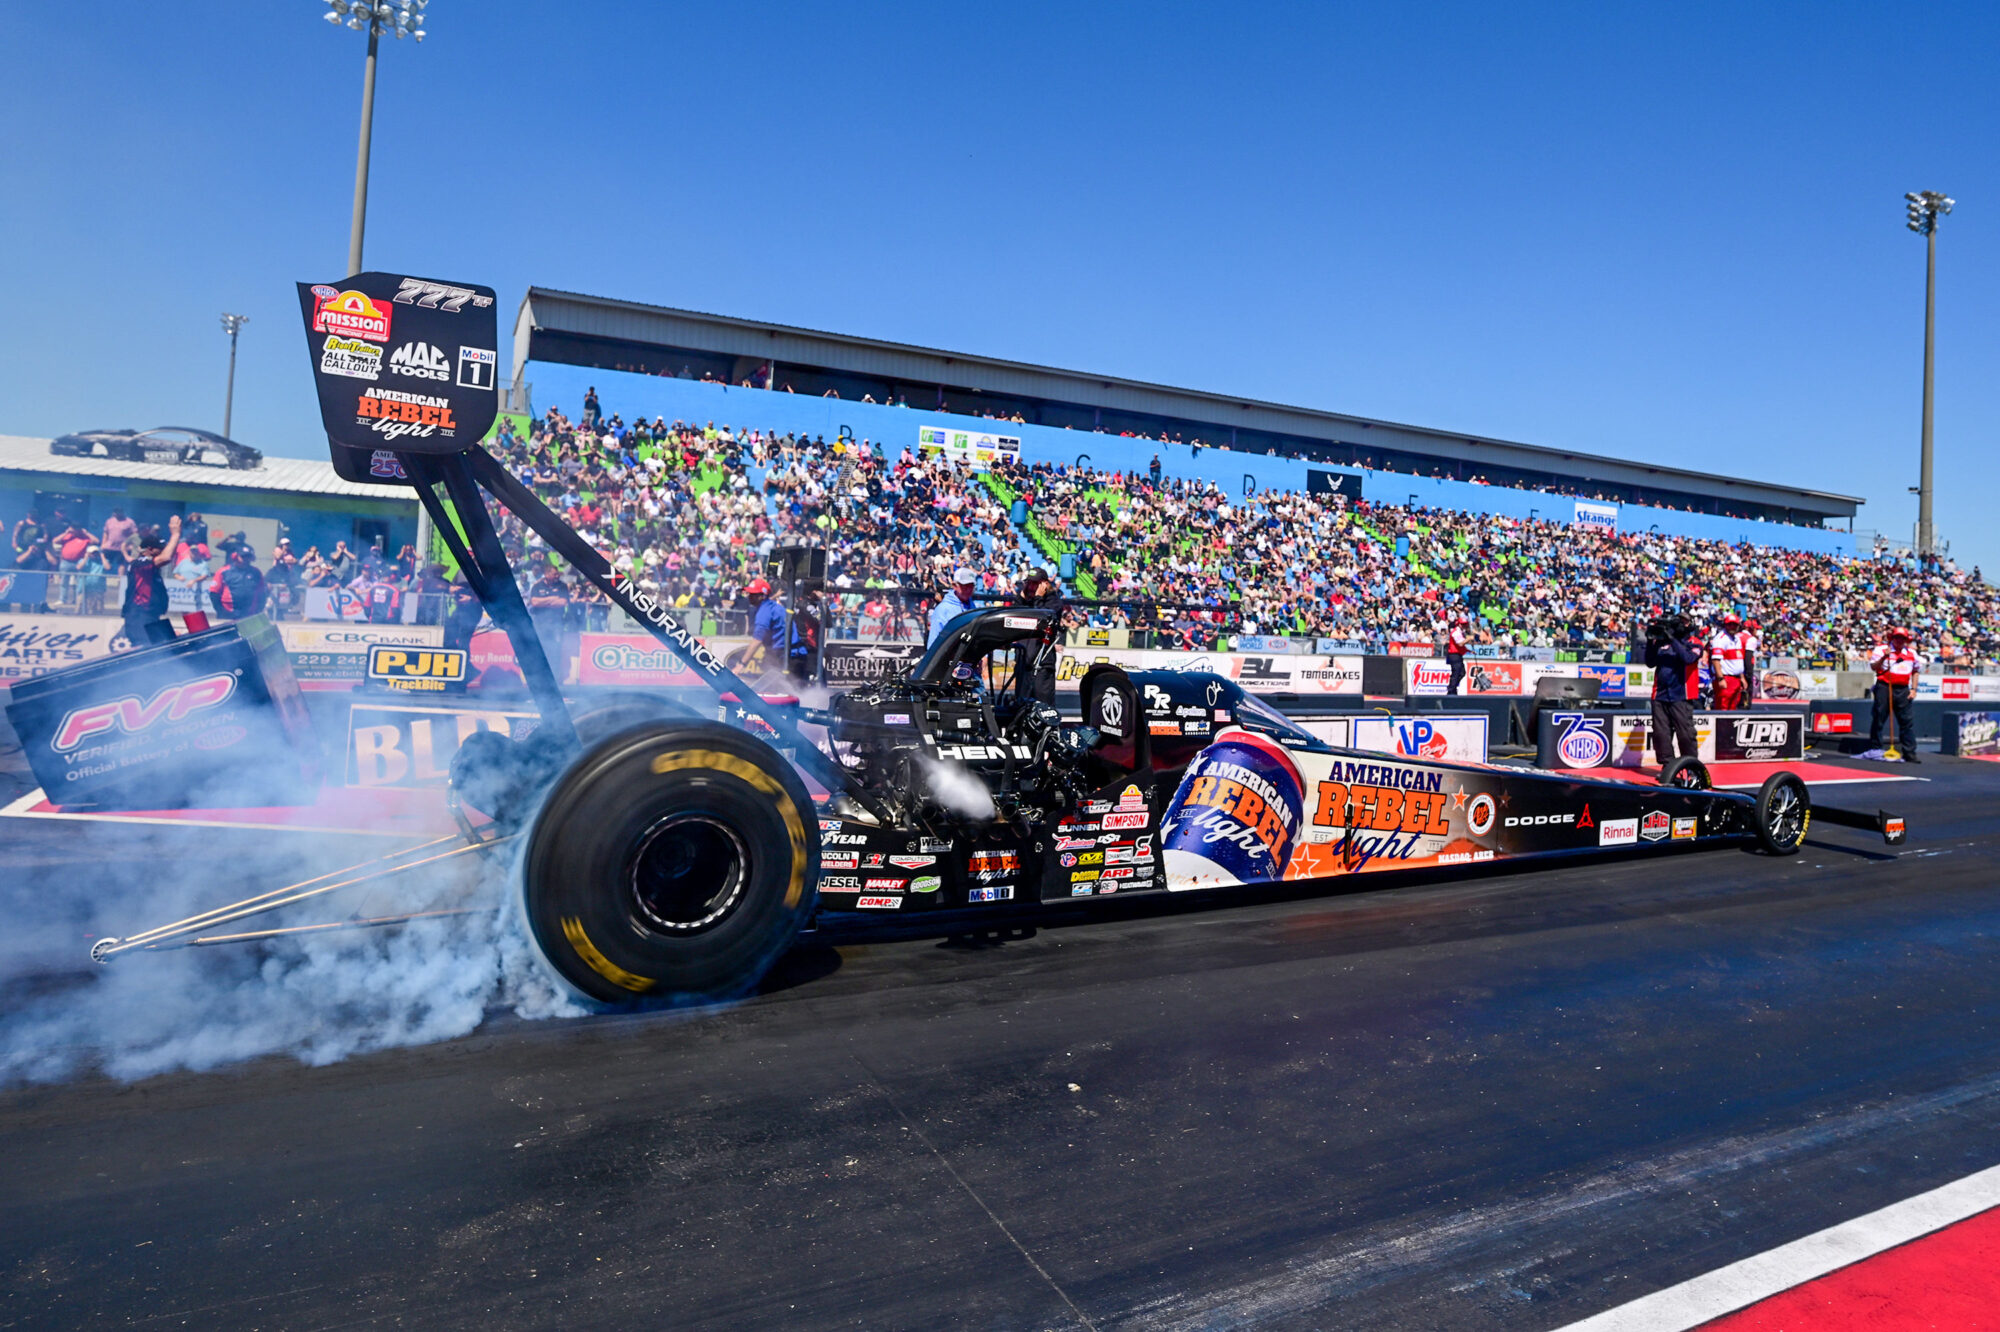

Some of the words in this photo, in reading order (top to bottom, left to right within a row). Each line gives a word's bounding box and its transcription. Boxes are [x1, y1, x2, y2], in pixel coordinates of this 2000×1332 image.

[393, 277, 475, 313] 777
[321, 311, 384, 332] MISSION
[325, 352, 346, 362] ALL
[389, 342, 450, 371] MAC
[461, 349, 494, 363] Mobil
[324, 359, 377, 373] CALLOUT
[389, 364, 450, 382] TOOLS
[470, 362, 481, 385] 1
[364, 387, 449, 409] AMERICAN
[356, 396, 457, 429] REBEL
[371, 416, 438, 441] light
[1243, 473, 1256, 495] D
[1576, 510, 1617, 526] Strange
[616, 578, 725, 677] INSURANCE
[1088, 630, 1110, 639] PJH
[325, 632, 379, 644] CBC
[379, 636, 424, 644] BANK
[597, 645, 686, 673] O'Reilly
[1399, 645, 1433, 657] MISSION
[297, 655, 330, 665] 229
[375, 650, 460, 677] PJH
[387, 677, 446, 691] TrackBite
[54, 673, 236, 752] FVP
[1620, 718, 1653, 727] MICKE
[1399, 721, 1433, 755] VP
[1739, 722, 1786, 744] UPR
[1568, 739, 1599, 759] NHRA
[65, 760, 118, 782] Official
[1329, 761, 1443, 792] AMERICAN
[1203, 760, 1293, 828] AMERICAN
[1313, 780, 1450, 836] REBEL
[1057, 823, 1101, 833] SUNNEN
[1104, 814, 1147, 828] SIMPSON
[1183, 775, 1288, 868] REBEL
[1504, 813, 1575, 827] DODGE
[1643, 814, 1669, 828] JHG
[1193, 805, 1271, 859] light
[1314, 834, 1329, 843] EST
[1603, 823, 1635, 840] Rinnai
[972, 849, 1016, 859] AMERICAN
[1332, 822, 1423, 872] light
[890, 855, 936, 864] COMPUTECH
[968, 855, 1022, 872] REBEL
[1062, 853, 1072, 866] VP
[1438, 853, 1472, 863] NASDAQ:
[1473, 850, 1494, 861] AREB
[976, 867, 1012, 885] light
[1102, 868, 1133, 879] ARP
[821, 878, 860, 888] JESEL
[865, 879, 904, 889] MANLEY
[859, 898, 893, 906] COMP
[970, 889, 1000, 902] Mobil
